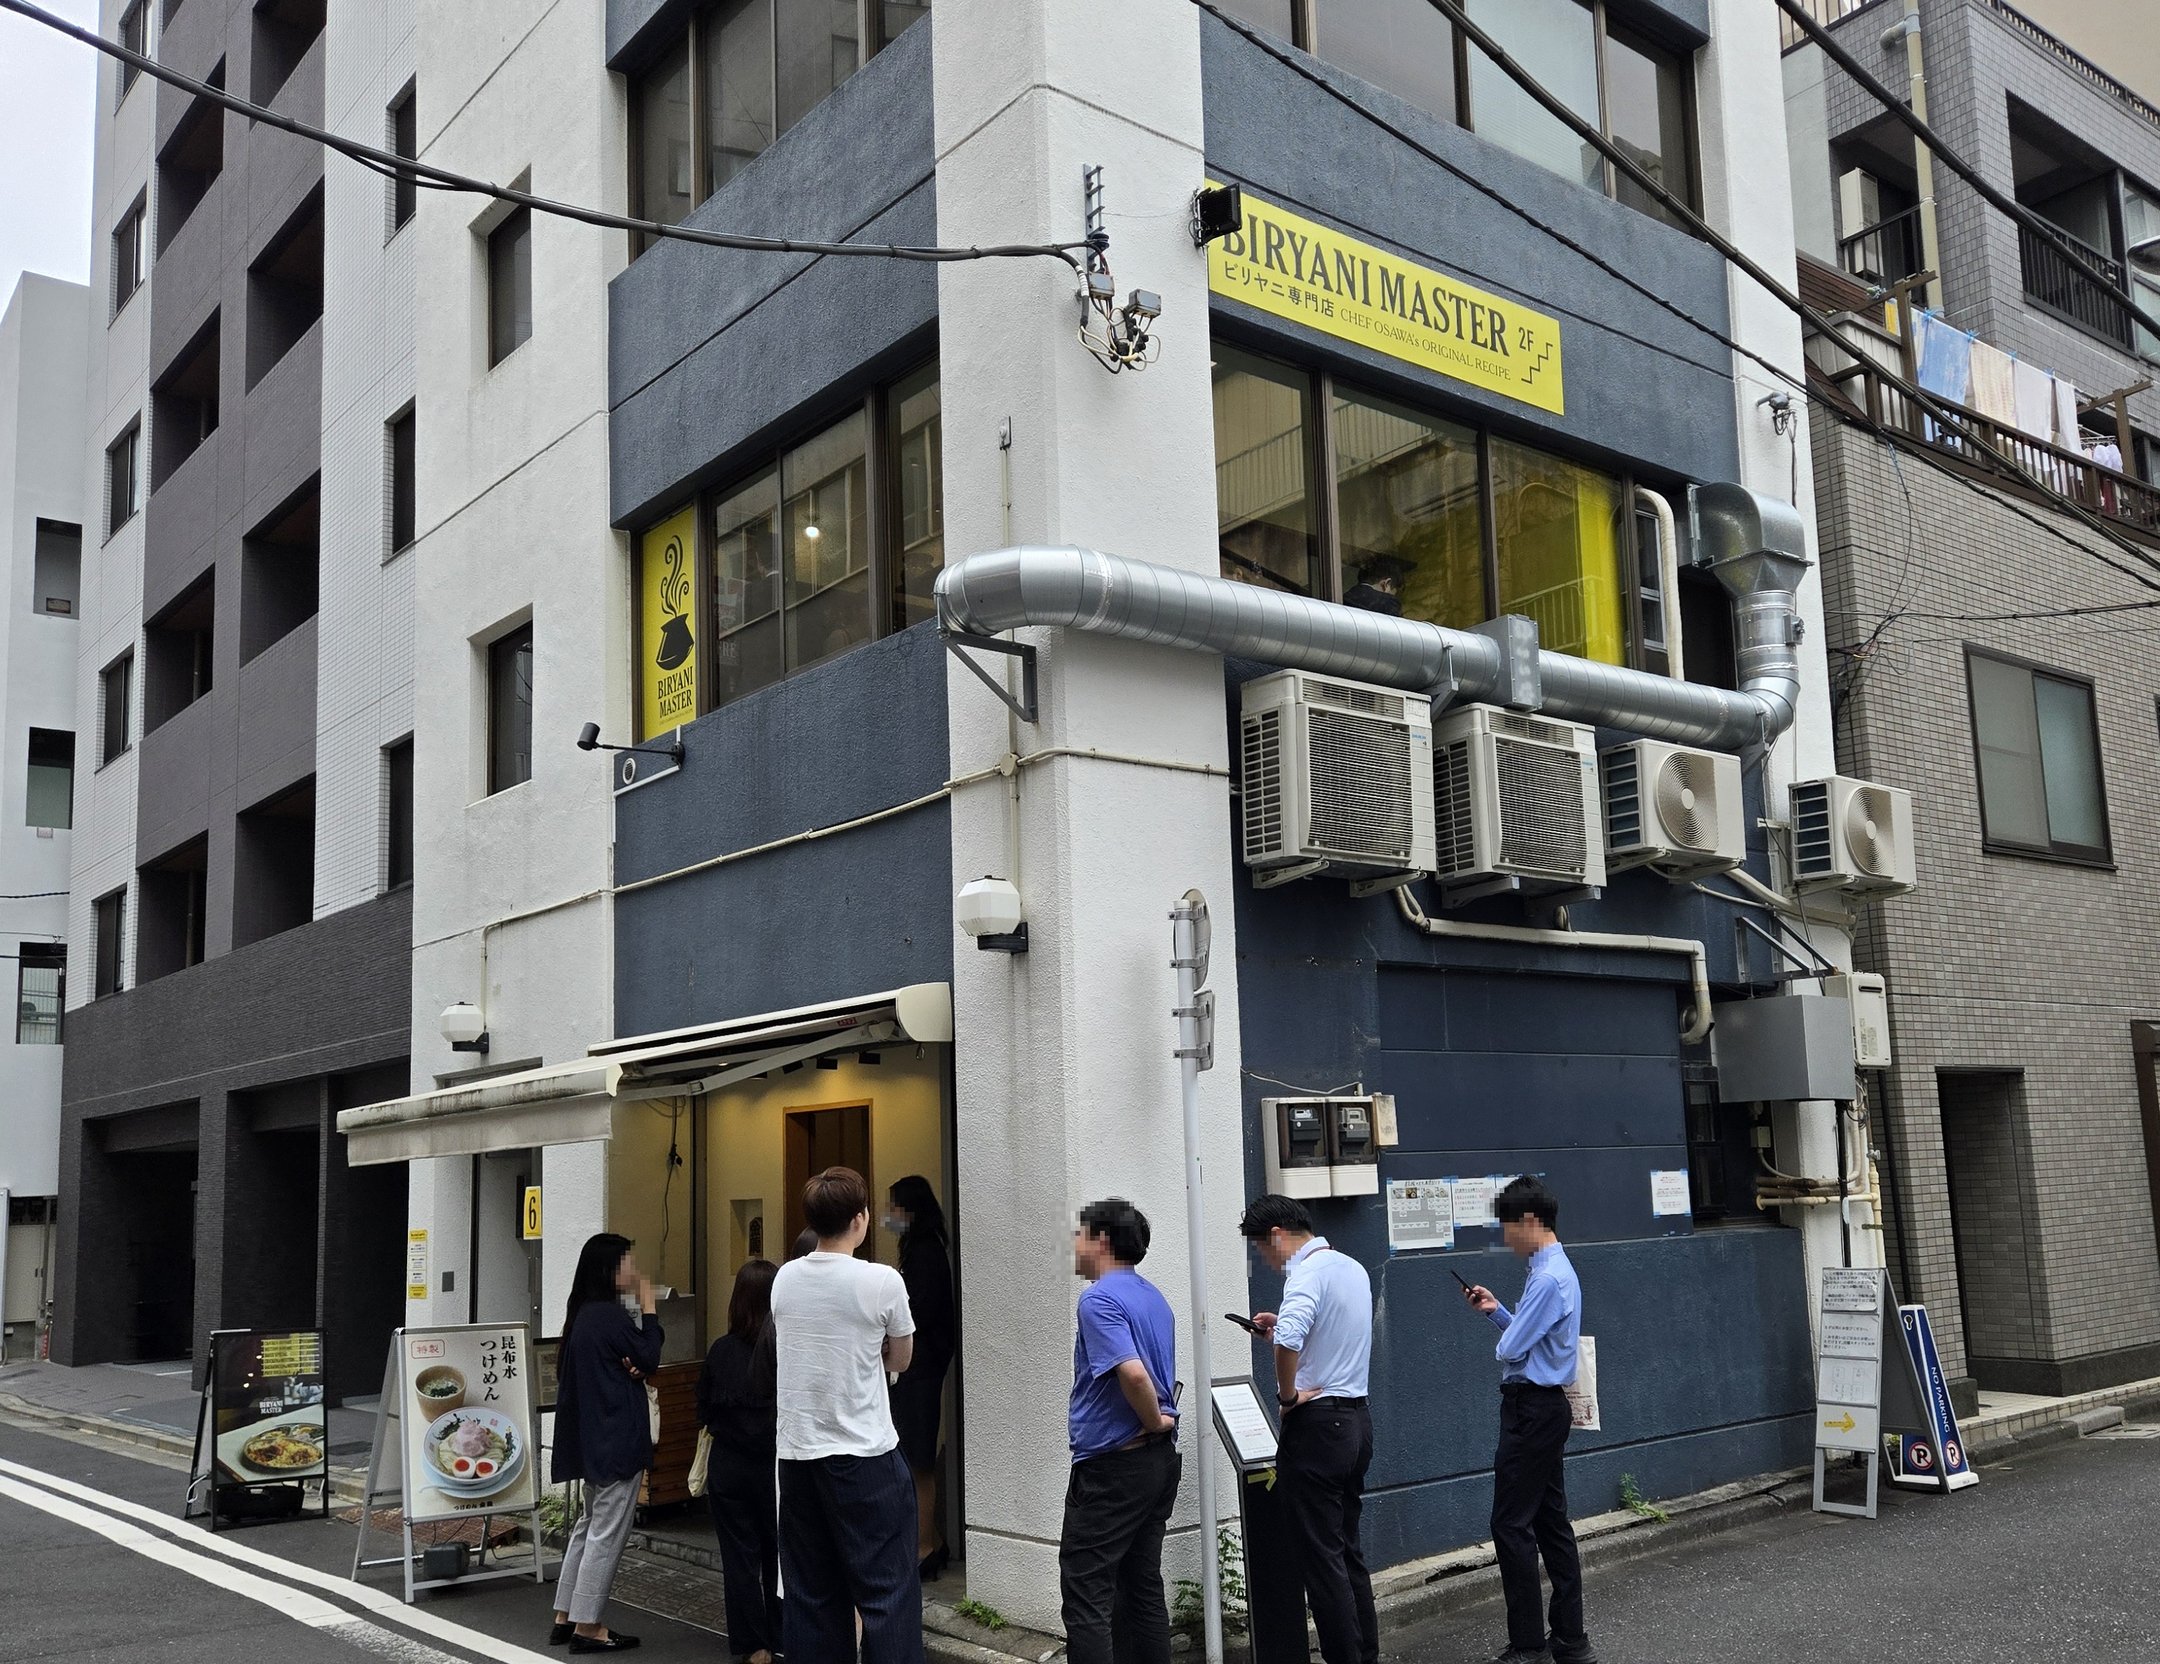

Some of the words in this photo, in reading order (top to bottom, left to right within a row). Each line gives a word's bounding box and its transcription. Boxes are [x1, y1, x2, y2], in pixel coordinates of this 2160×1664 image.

[1224, 260, 1335, 318] ビリヤニ専門店
[1378, 264, 1510, 358] MASTER
[1340, 308, 1373, 330] CHEF
[1374, 320, 1420, 347] OSAWA's
[1421, 338, 1474, 367] ORIGINAL
[1474, 357, 1511, 381] RECIPE
[1518, 326, 1535, 353] 2F
[658, 666, 693, 700] BIRYANI
[660, 689, 692, 718] MASTER
[528, 1195, 538, 1231] 6
[480, 1340, 500, 1402] つけめん
[501, 1335, 518, 1379] 昆布水
[1931, 1366, 1940, 1385] NO
[260, 1407, 282, 1415] MASTER
[1935, 1386, 1951, 1433] PARKING
